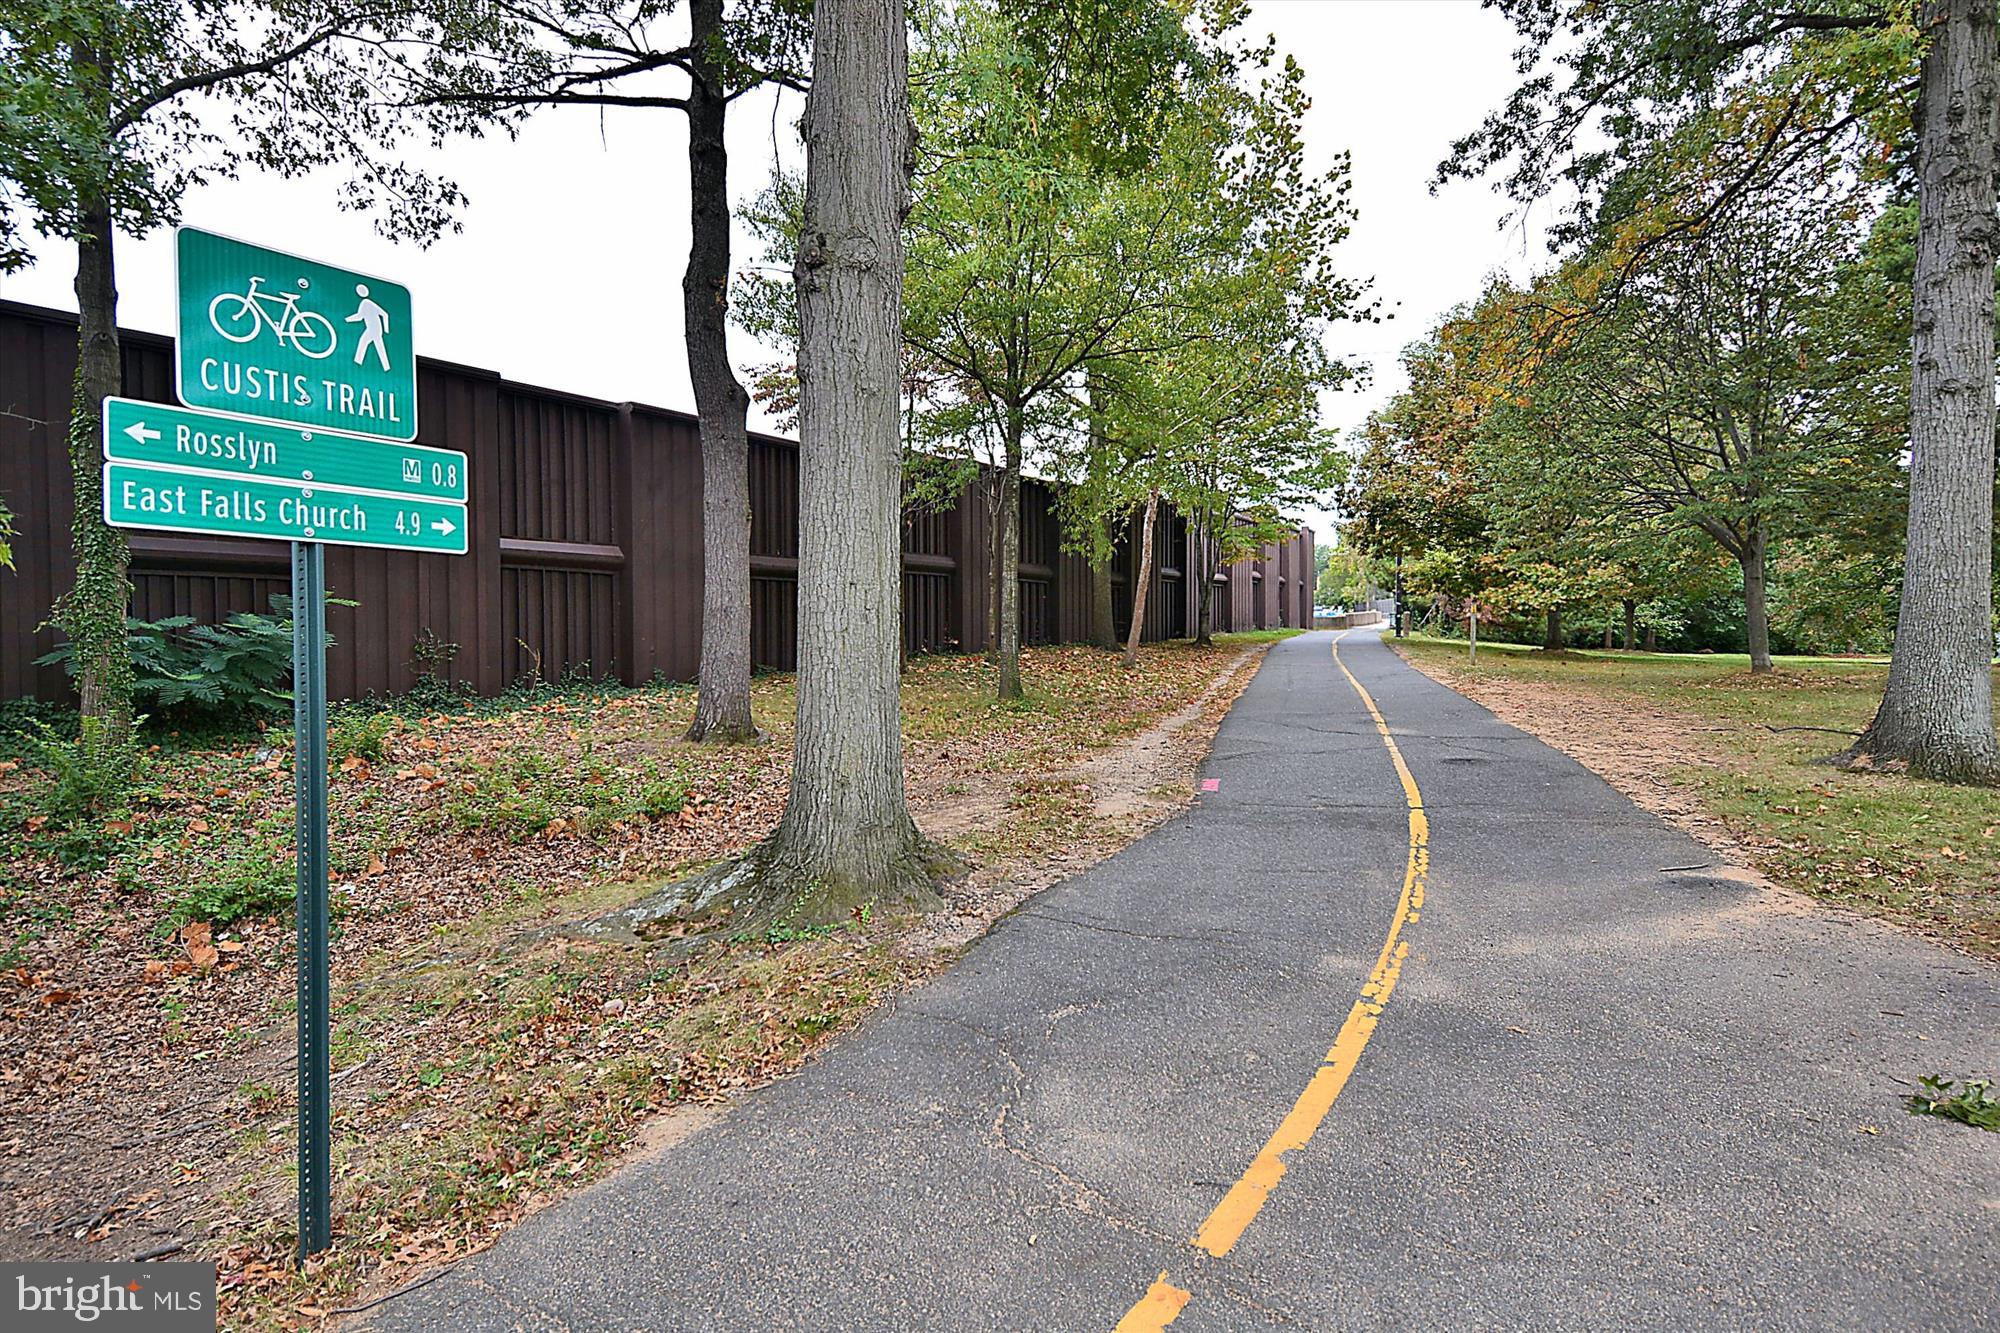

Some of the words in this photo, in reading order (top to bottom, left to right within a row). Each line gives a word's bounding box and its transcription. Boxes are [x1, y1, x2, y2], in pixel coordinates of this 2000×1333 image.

[200, 358, 308, 406] CUSTIS
[322, 379, 401, 422] TRAIL
[176, 424, 277, 469] Rosslyn
[404, 460, 420, 477] M
[432, 462, 457, 488] 0.8
[123, 480, 186, 515] East
[201, 489, 266, 523] Falls
[279, 498, 367, 531] Church
[395, 512, 421, 536] 4.9
